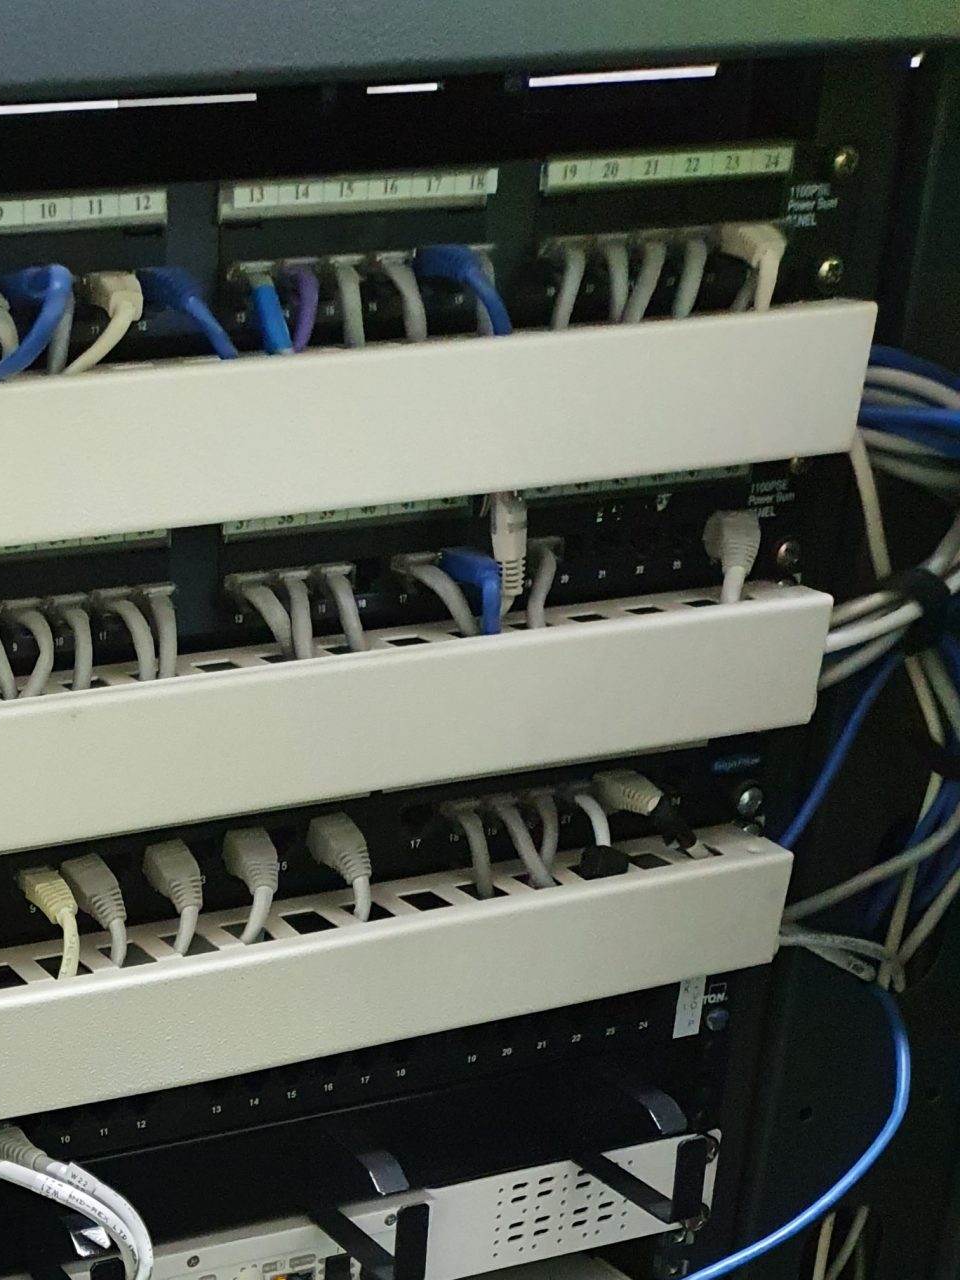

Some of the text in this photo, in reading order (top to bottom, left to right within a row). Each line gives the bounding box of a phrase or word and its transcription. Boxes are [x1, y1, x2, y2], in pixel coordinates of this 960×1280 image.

[562, 153, 780, 179] 19 20 21 22 23 24
[249, 174, 484, 203] 13 14 15 16 17 18
[40, 202, 57, 219] 10
[89, 198, 103, 215] 11
[135, 194, 151, 211] 12
[28, 903, 37, 914] 9
[410, 837, 422, 849] 17
[60, 1134, 71, 1144] 10
[100, 1127, 109, 1137] 11
[136, 1119, 146, 1129] 12
[211, 1104, 222, 1114] 13
[249, 1097, 259, 1107] 14
[286, 1089, 297, 1099] 15
[360, 1075, 370, 1085] 17
[501, 1047, 513, 1057] 20
